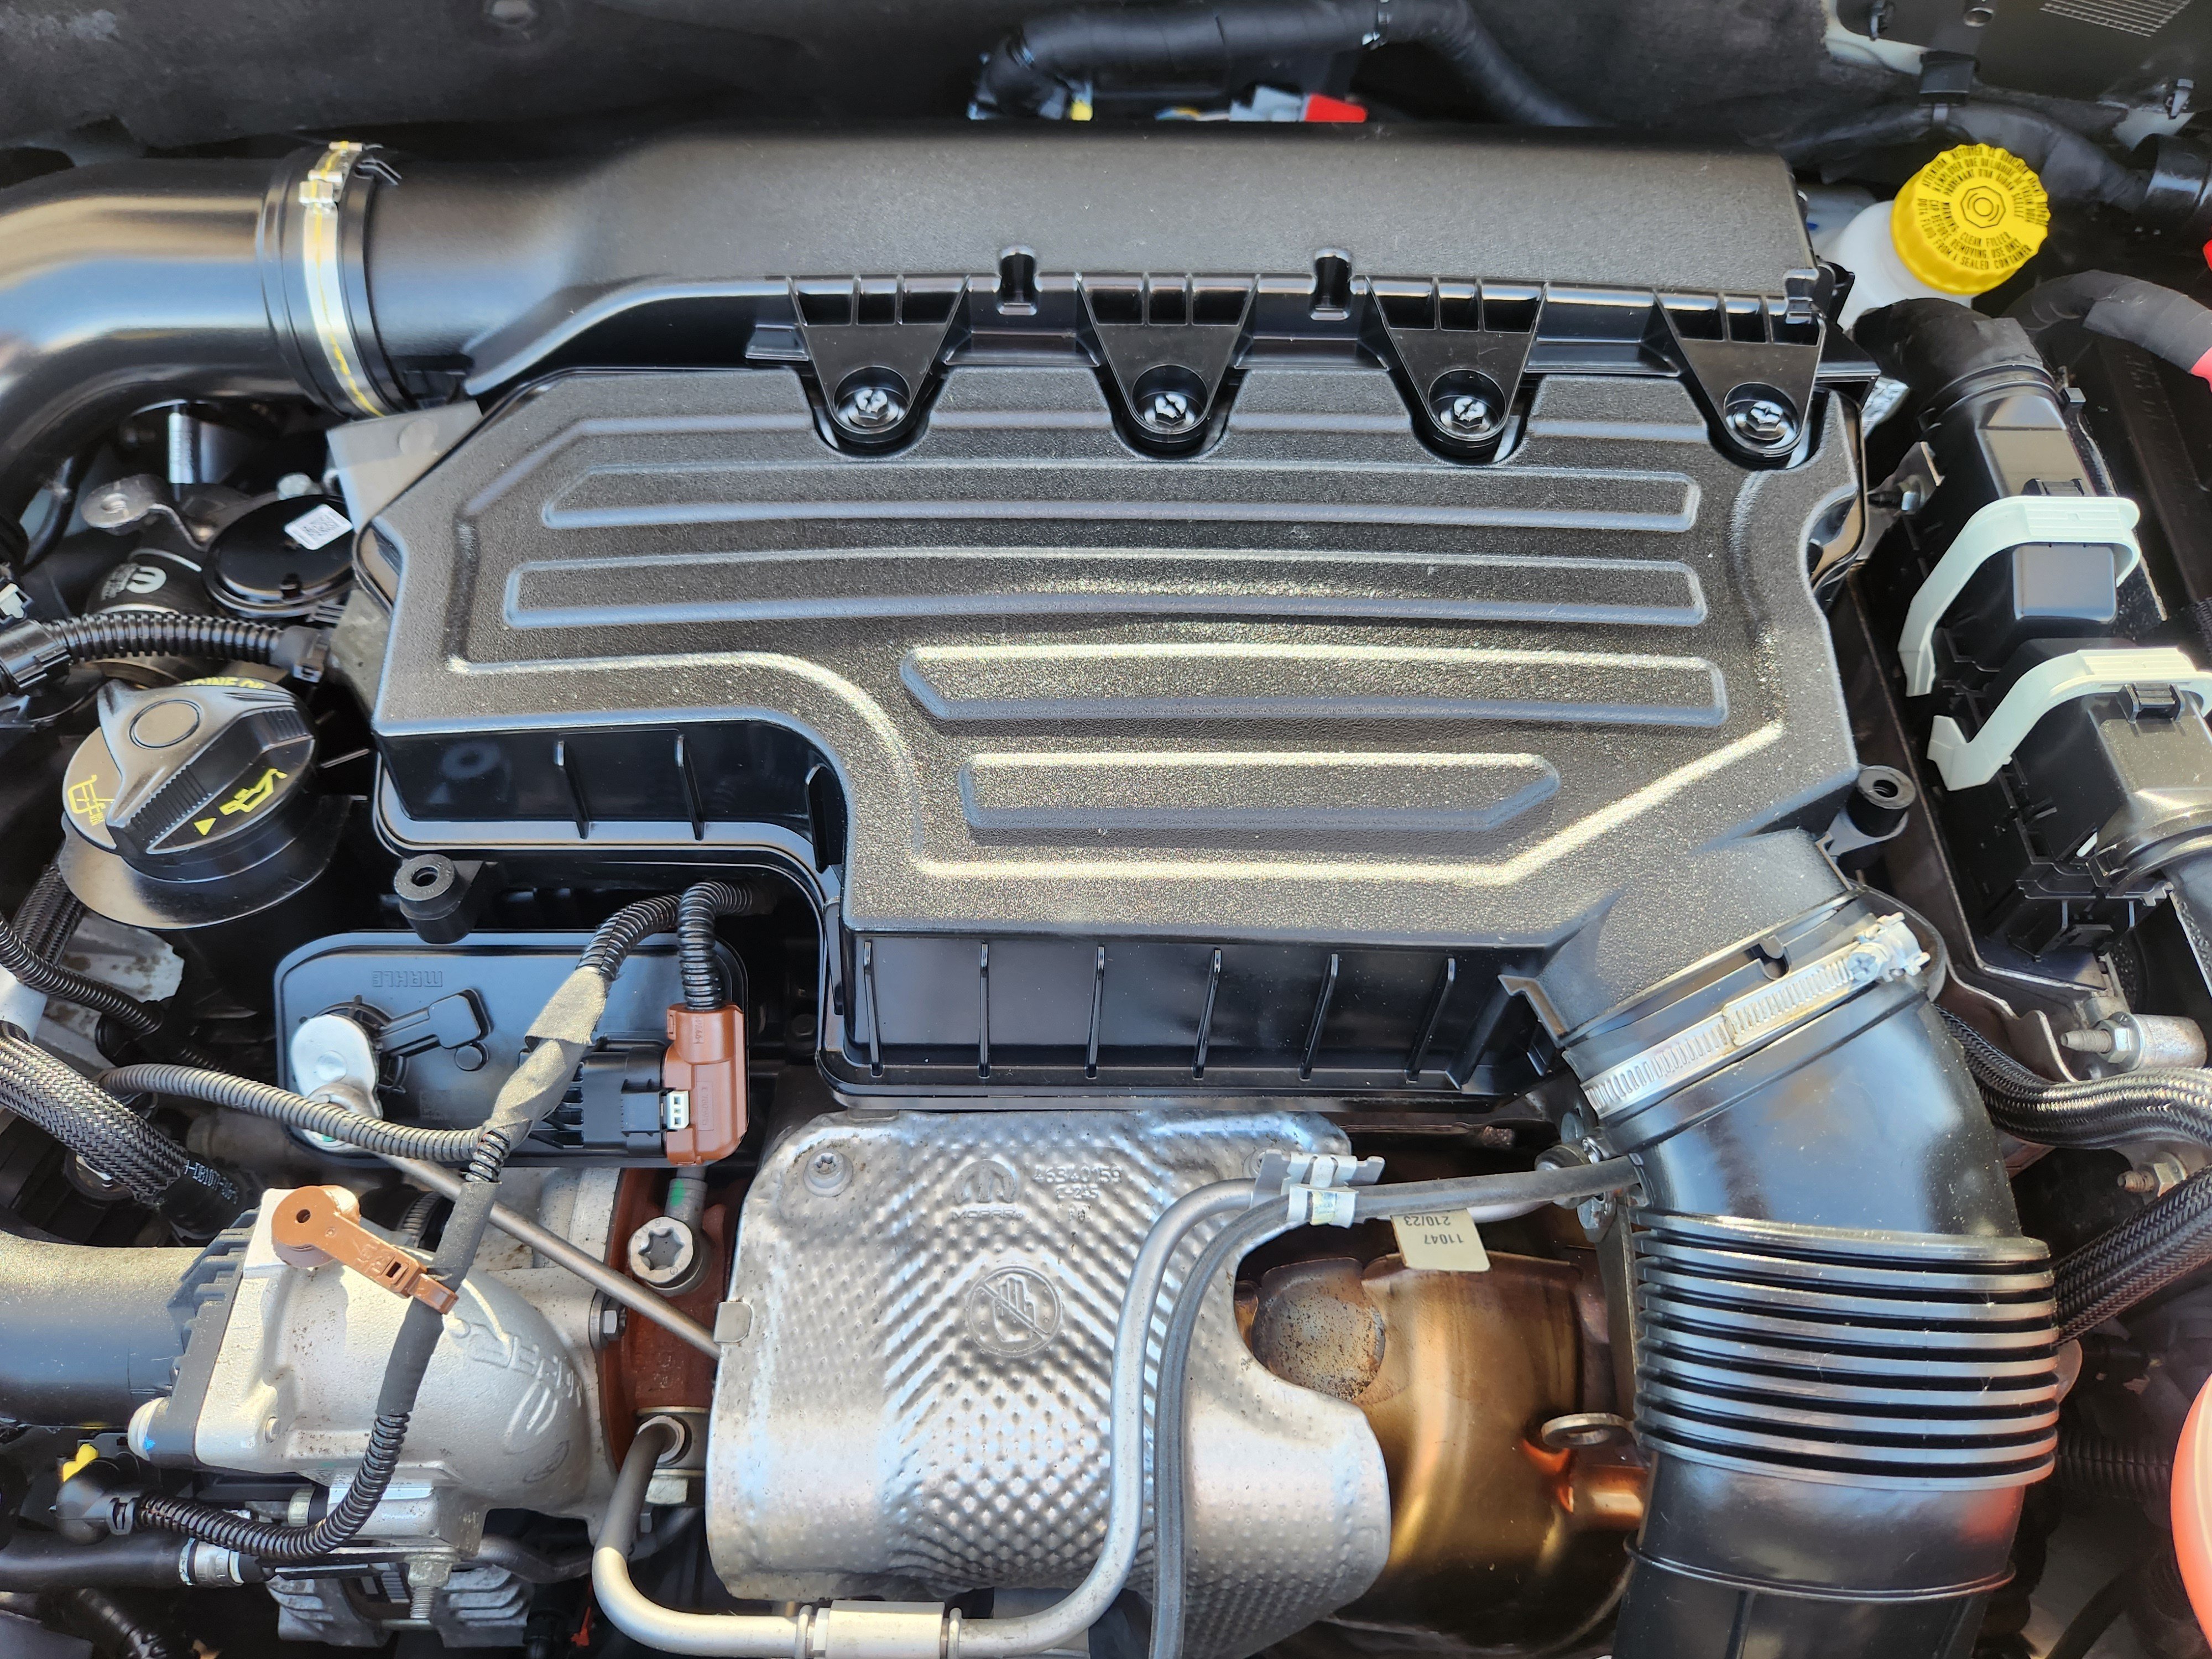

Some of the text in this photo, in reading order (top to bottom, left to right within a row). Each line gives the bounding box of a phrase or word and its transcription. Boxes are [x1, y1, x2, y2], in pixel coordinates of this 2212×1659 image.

[1960, 232, 1981, 246] CLEAN
[1986, 231, 2011, 246] FILLER
[1934, 239, 1951, 255] FROM
[1960, 257, 1989, 270] SEALED
[1994, 245, 2033, 269] CONTAINER
[1991, 247, 2005, 258] USE
[2007, 238, 2022, 253] ONLY
[372, 971, 443, 988] MAHLE
[951, 1208, 1015, 1220] MOPAR
[1404, 1215, 1451, 1227] 210/23
[1423, 1234, 1463, 1244] 11047
